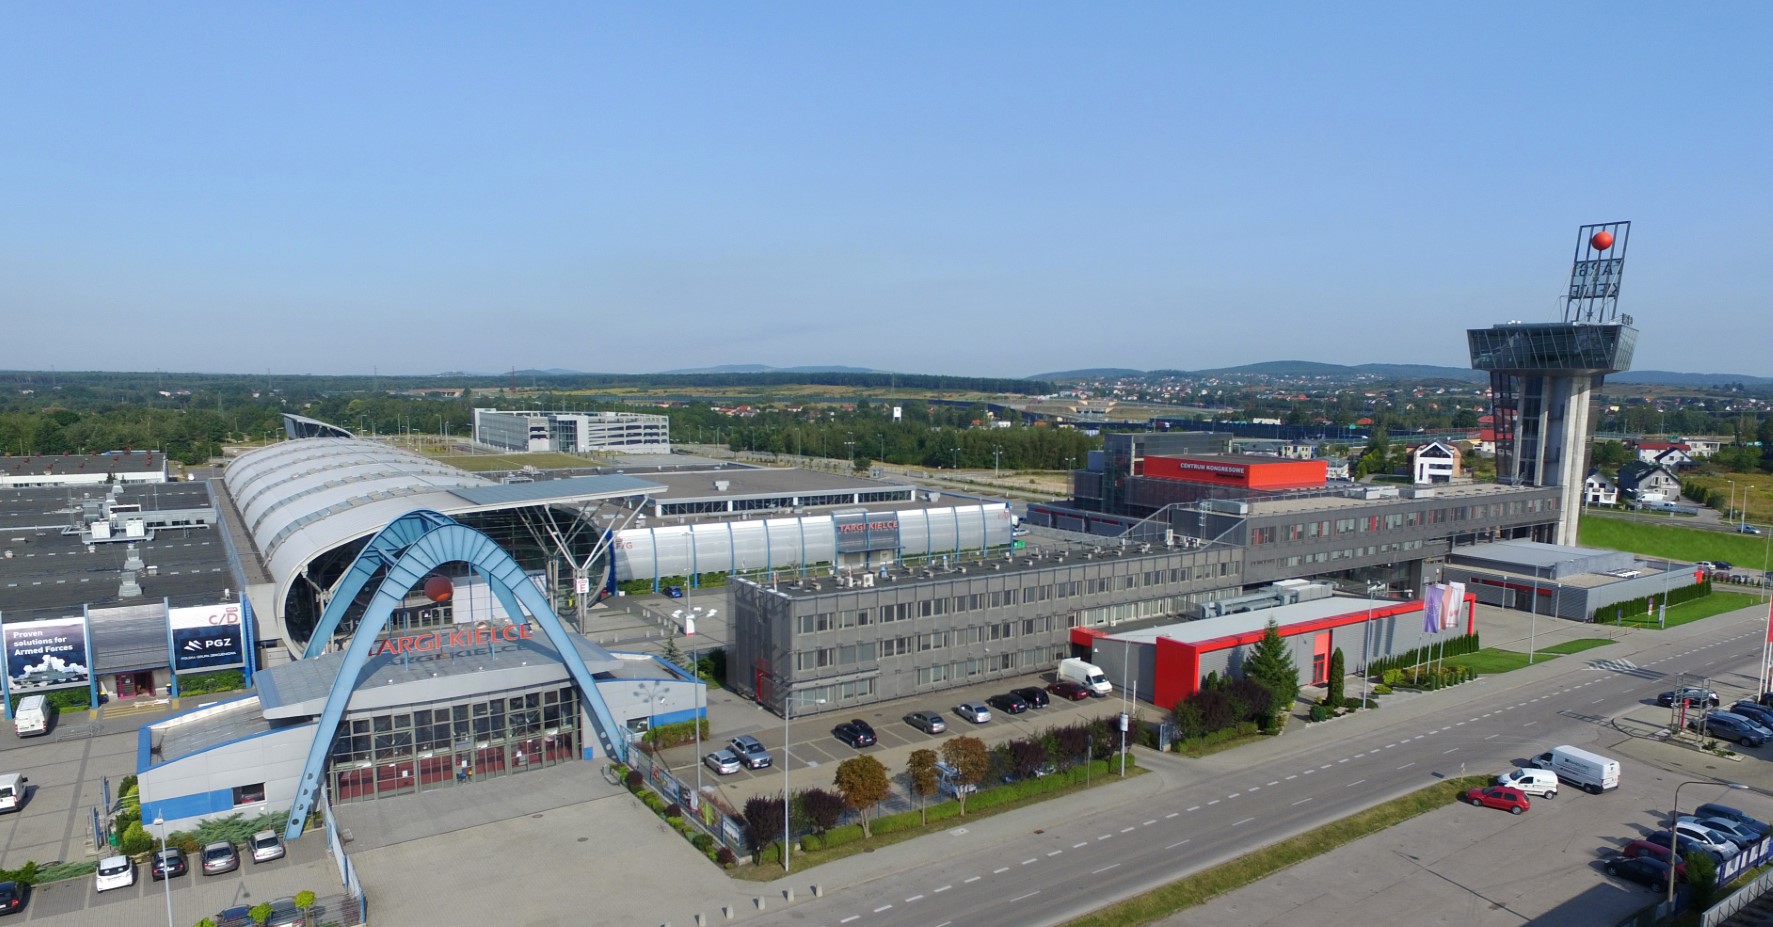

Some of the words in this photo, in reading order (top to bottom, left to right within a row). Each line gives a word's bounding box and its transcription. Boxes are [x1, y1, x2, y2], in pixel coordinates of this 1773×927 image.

[839, 523, 866, 532] TARGI
[869, 520, 898, 530] KIELCE
[208, 613, 238, 626] C/D
[13, 630, 43, 638] Proven
[450, 622, 533, 648] KIELCE
[14, 639, 53, 647] solutions
[205, 638, 232, 648] PGZ
[15, 647, 43, 656] Armed
[45, 644, 73, 653] Forces
